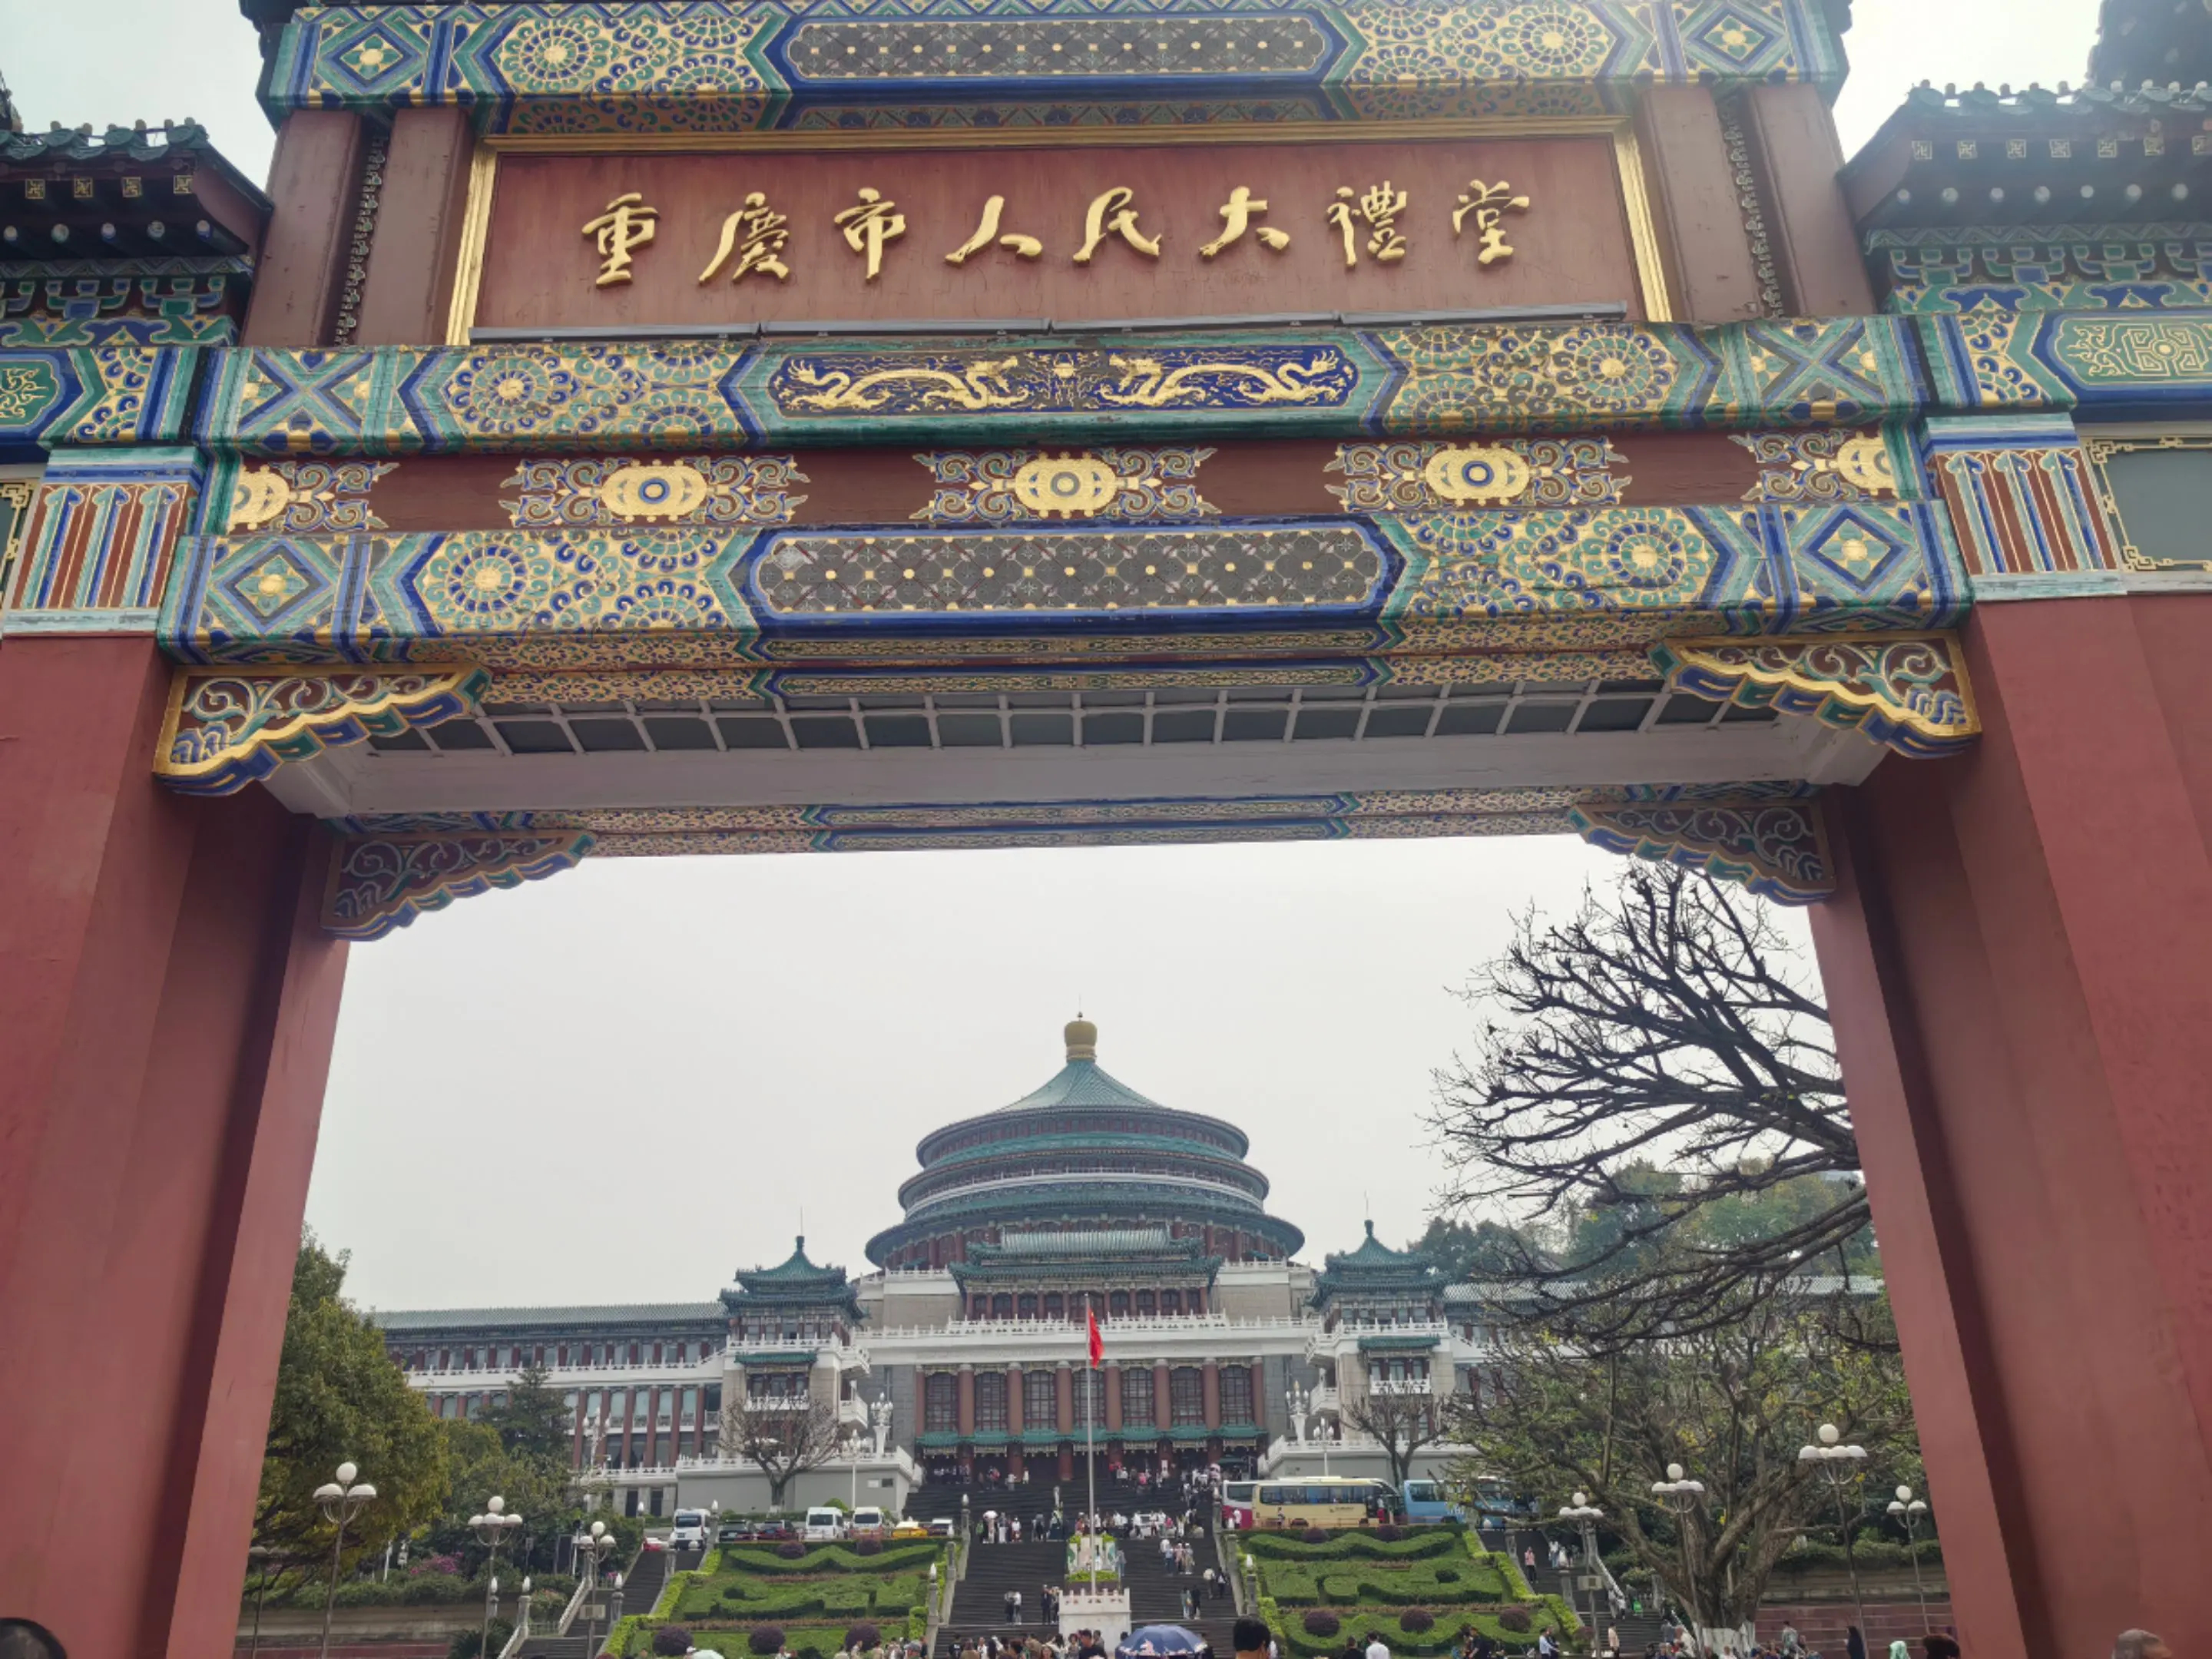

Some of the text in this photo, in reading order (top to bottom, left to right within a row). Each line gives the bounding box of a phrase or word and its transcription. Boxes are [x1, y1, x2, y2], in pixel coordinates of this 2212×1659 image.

[582, 179, 1532, 286] 重慶市人民大禮堂
